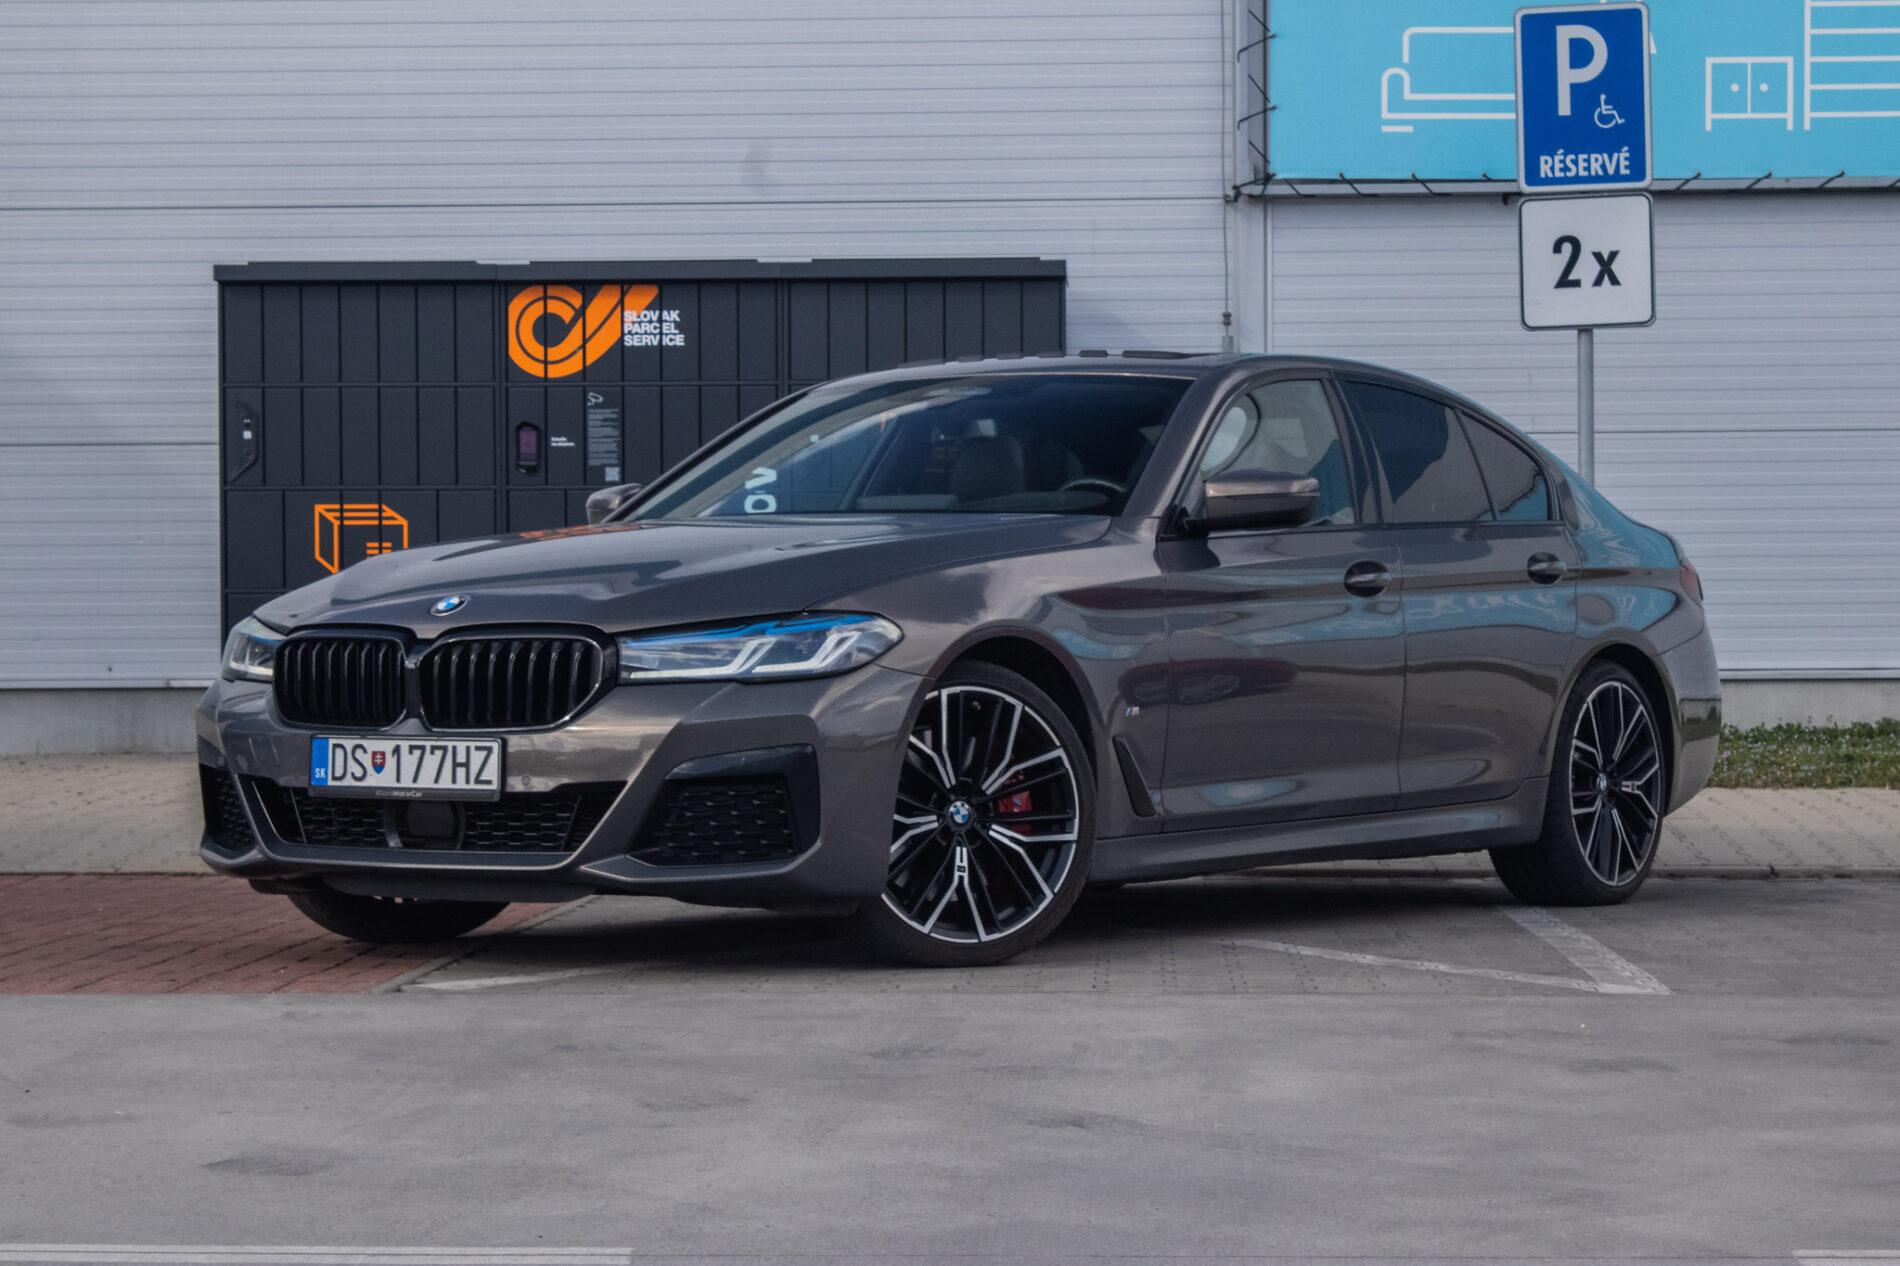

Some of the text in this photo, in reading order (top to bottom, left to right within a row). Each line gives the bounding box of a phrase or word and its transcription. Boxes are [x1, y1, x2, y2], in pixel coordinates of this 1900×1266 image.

[1555, 24, 1609, 117] P
[1539, 146, 1631, 178] RÉSERVÉ
[1552, 235, 1622, 289] 2x
[623, 310, 681, 321] SLOVAK
[623, 322, 680, 334] PARCEL
[623, 334, 686, 346] SERVICE
[315, 767, 326, 778] SK
